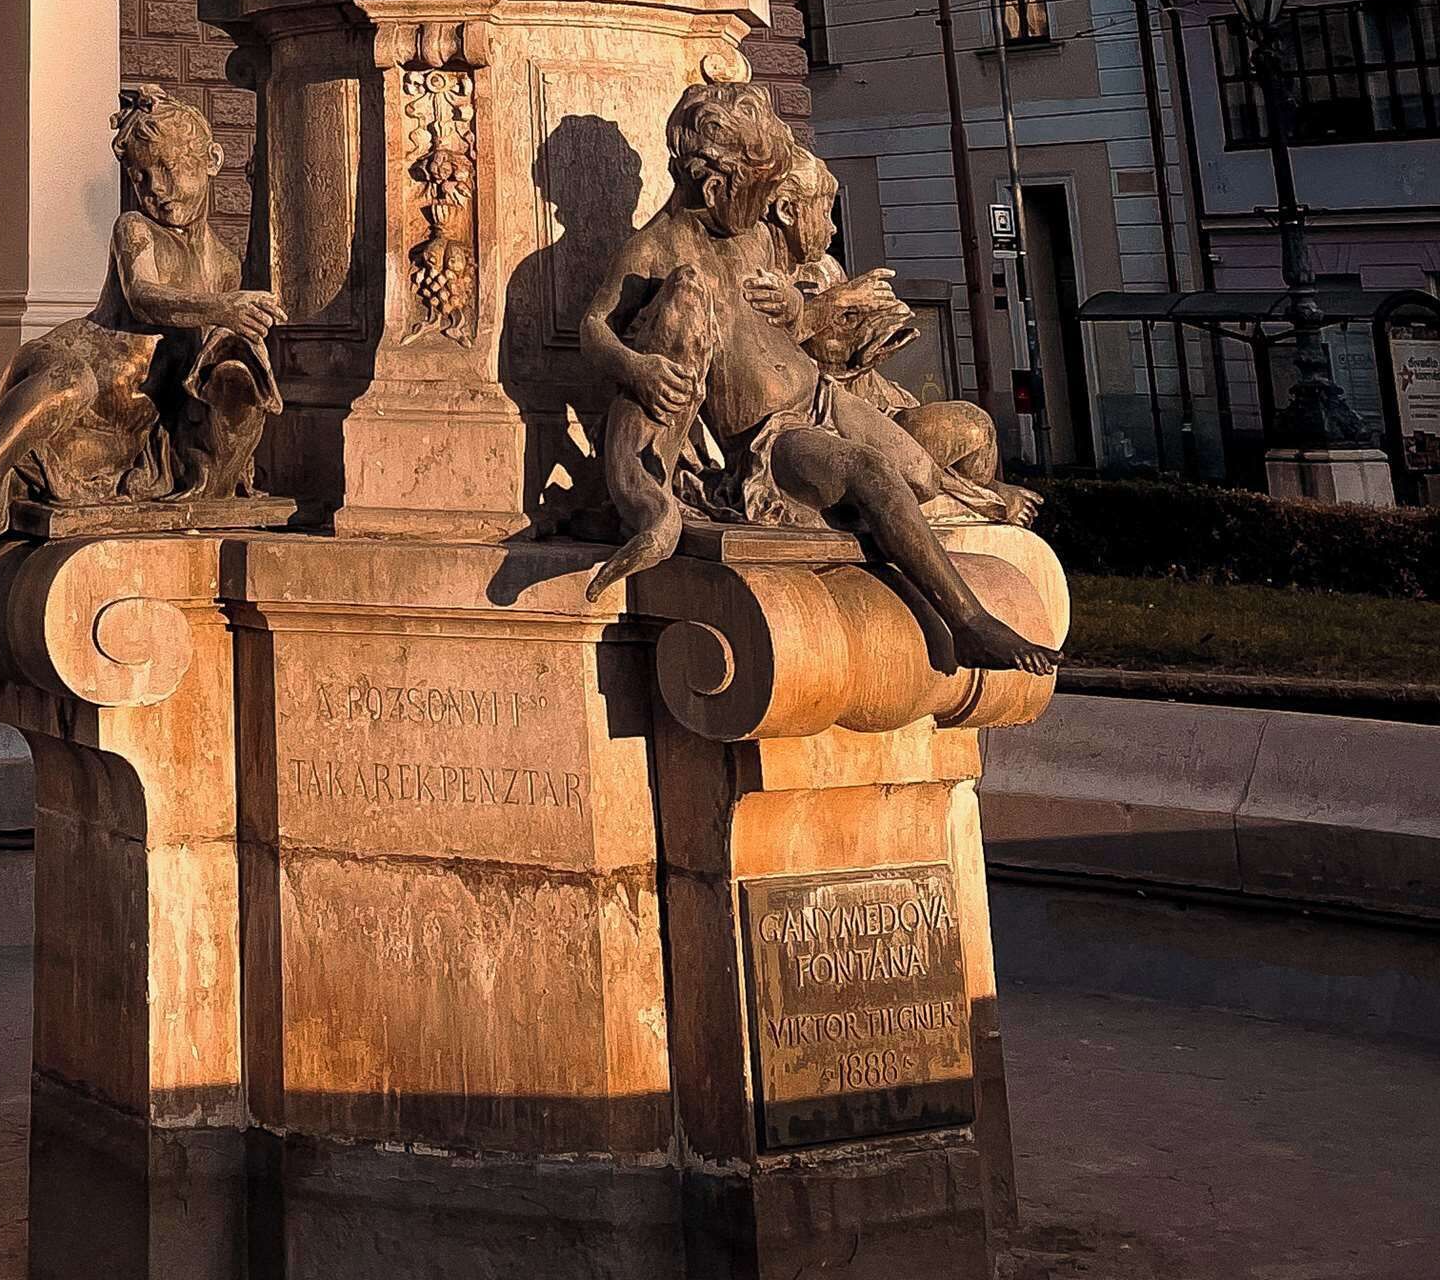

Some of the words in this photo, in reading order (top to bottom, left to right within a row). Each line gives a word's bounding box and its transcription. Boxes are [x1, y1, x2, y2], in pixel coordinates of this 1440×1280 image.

[759, 896, 954, 944] GANYMEDOVA
[768, 1012, 861, 1049] VIKTOR
[837, 1048, 898, 1092] 1888
